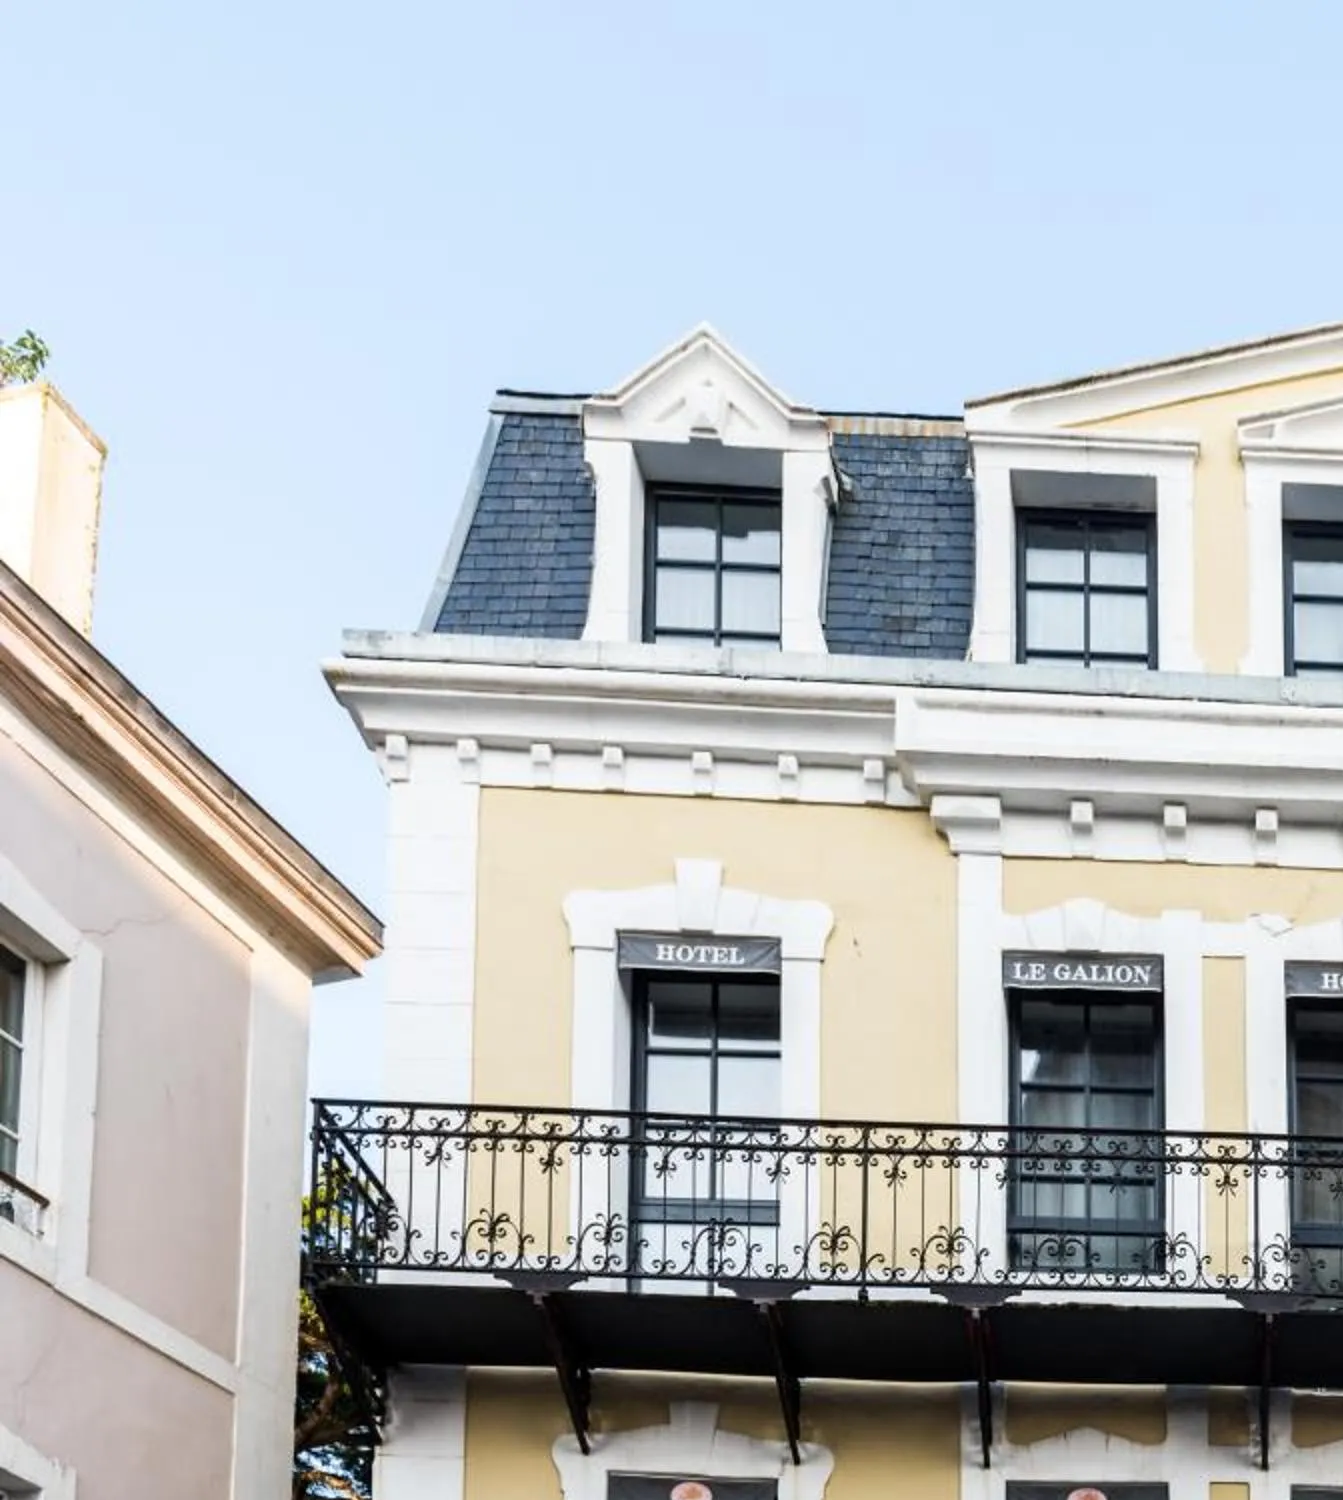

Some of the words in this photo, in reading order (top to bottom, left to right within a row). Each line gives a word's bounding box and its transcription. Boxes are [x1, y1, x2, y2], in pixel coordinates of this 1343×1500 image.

[656, 944, 746, 964] HOTEL
[1012, 963, 1044, 981] LE
[1054, 964, 1152, 984] GALION
